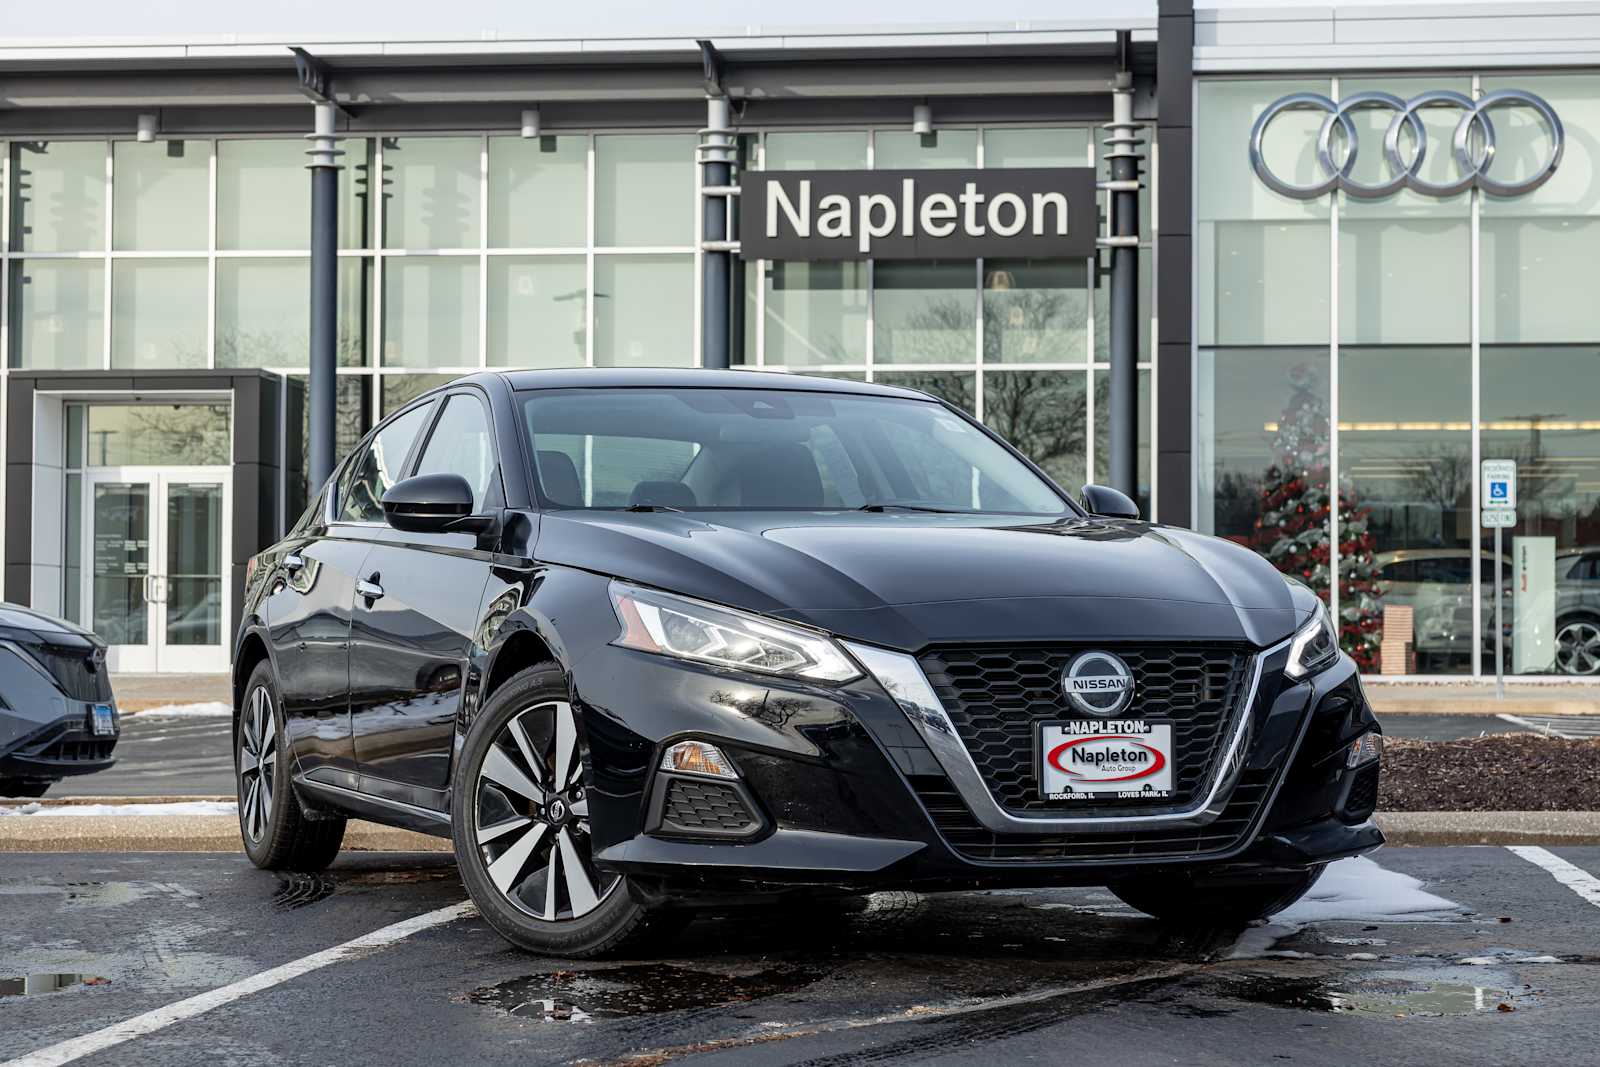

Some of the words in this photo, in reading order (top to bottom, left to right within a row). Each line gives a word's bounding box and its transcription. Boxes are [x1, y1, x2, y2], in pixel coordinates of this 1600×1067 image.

[766, 178, 1069, 252] Napleton
[1073, 679, 1126, 690] NISSAN
[1069, 720, 1145, 734] NAPLETON
[1071, 746, 1148, 766] Napleton
[1101, 764, 1117, 772] Auto
[1117, 764, 1137, 773] Group
[1088, 791, 1096, 800] IL
[1118, 790, 1140, 799] LOVES
[1161, 789, 1169, 798] IL
